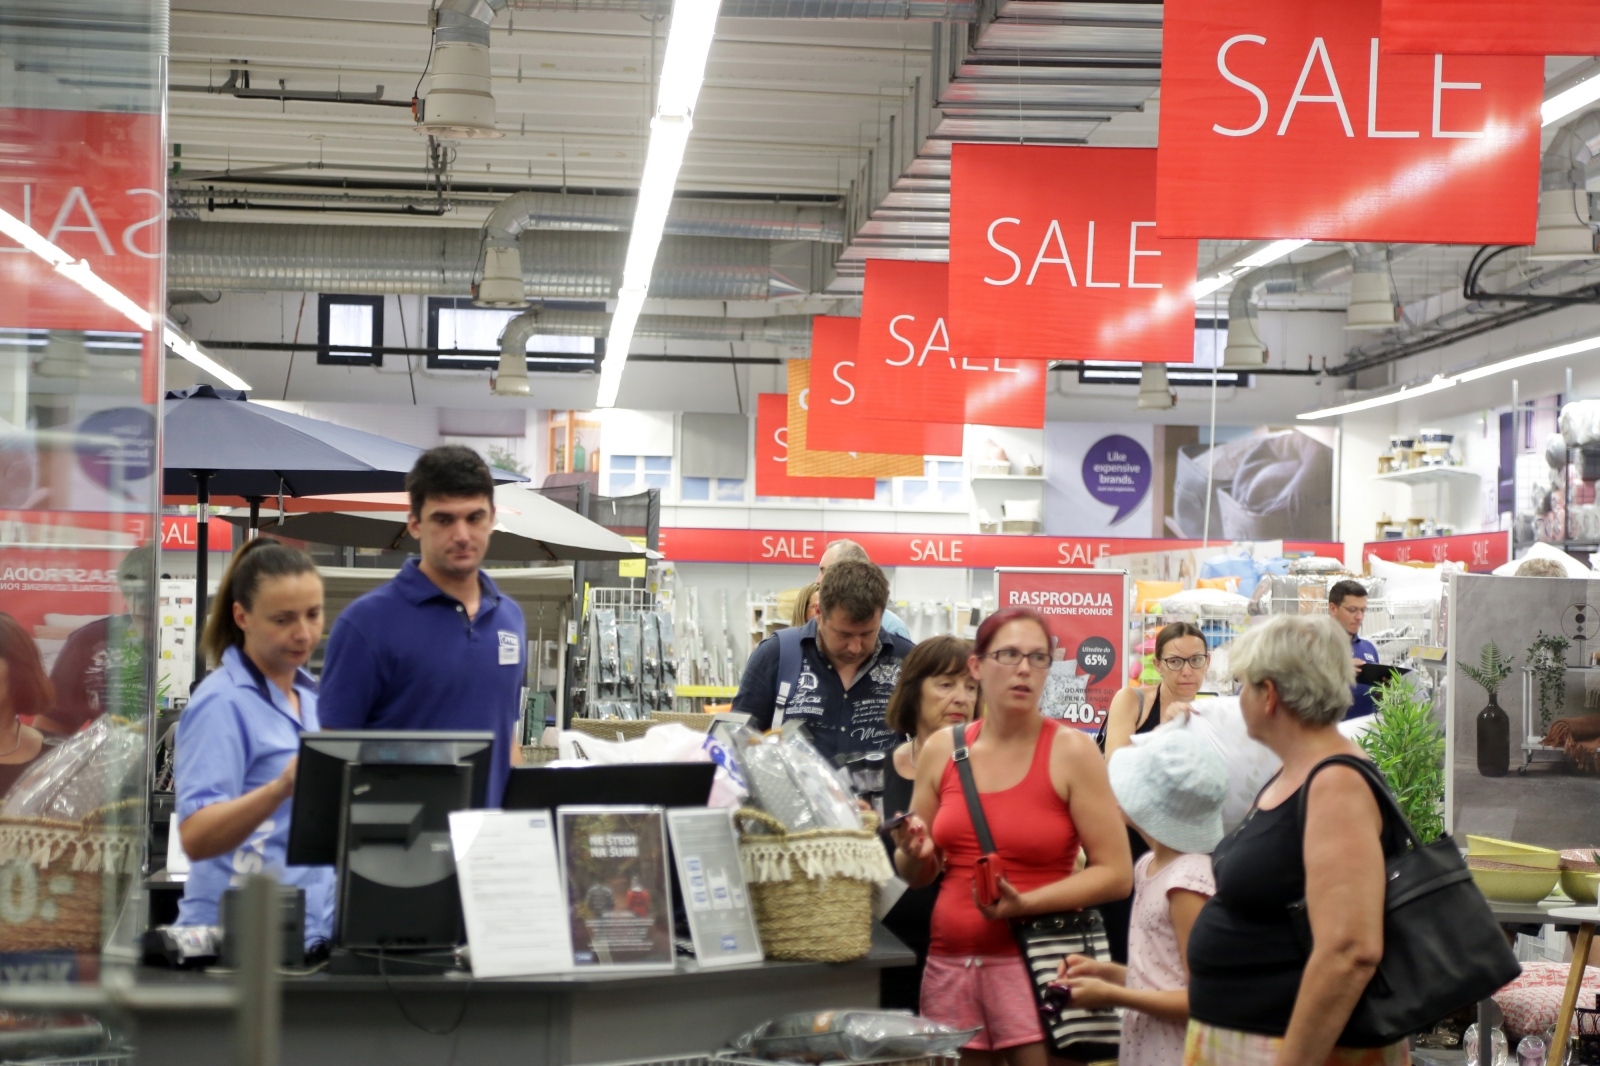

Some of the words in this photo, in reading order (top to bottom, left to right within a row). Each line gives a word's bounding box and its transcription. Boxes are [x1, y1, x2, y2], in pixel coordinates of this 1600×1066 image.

[1212, 34, 1488, 138] SALE
[983, 217, 1163, 289] SALE
[1107, 451, 1127, 462] Like
[1093, 463, 1141, 474] expensive
[1099, 474, 1135, 485] brands.
[761, 536, 815, 559] SALE
[909, 539, 963, 562] SALE
[1009, 591, 1113, 606] RASPRODAJA
[1043, 607, 1077, 615] IZVRSNE
[1079, 608, 1113, 616] PONUDE
[1084, 655, 1107, 666] 65%
[1063, 703, 1107, 724] 40.-
